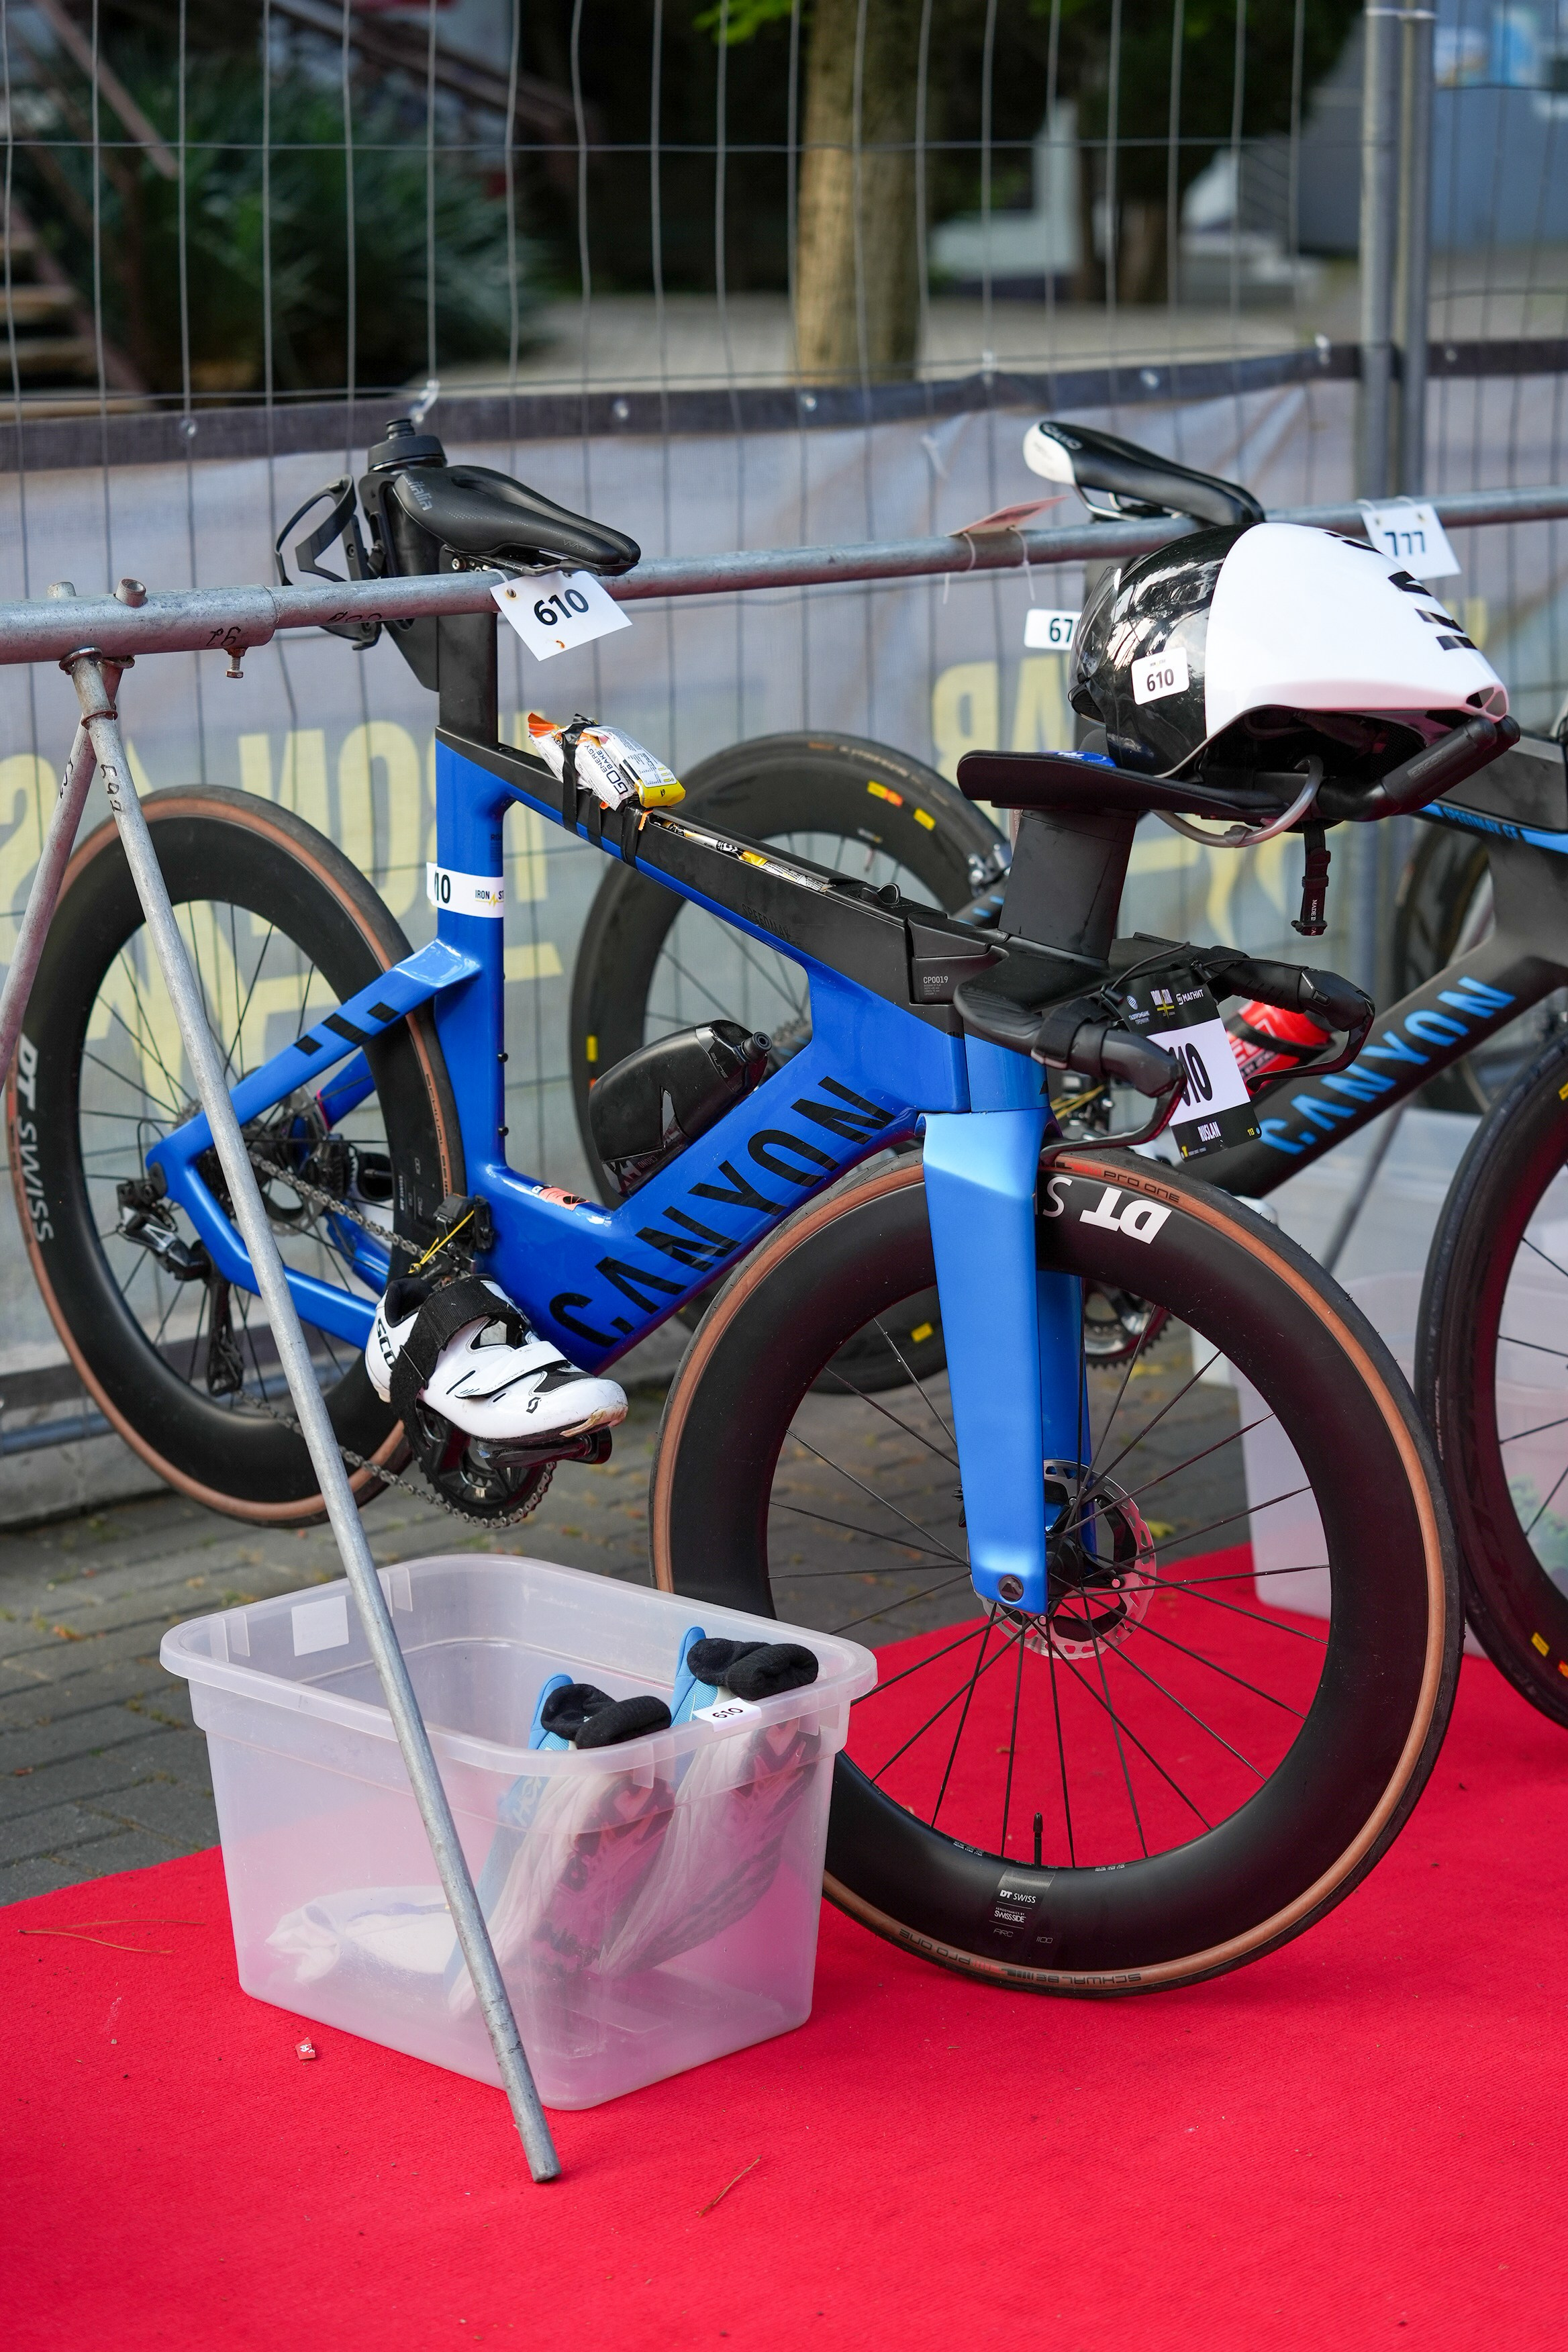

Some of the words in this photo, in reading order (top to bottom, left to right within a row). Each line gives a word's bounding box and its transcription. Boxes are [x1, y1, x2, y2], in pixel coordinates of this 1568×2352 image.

[562, 539, 594, 553] WATT
[1384, 532, 1426, 556] 777
[534, 589, 589, 626] 610
[1050, 618, 1079, 642] 67
[1146, 669, 1174, 691] 610
[584, 745, 608, 773] ENERGY
[596, 749, 614, 771] BAKE
[606, 770, 628, 795] GO
[434, 871, 451, 903] 10
[475, 889, 490, 899] IRON
[923, 975, 948, 984] CP0019
[1182, 989, 1204, 1003] МАГНИТ
[17, 1032, 39, 1112] DT
[1261, 977, 1516, 1155] CANYON
[1197, 1121, 1222, 1142] RUSLAN
[1247, 1128, 1255, 1136] 113
[637, 1155, 658, 1169] CRONO
[17, 1116, 55, 1242] SWISS
[548, 1076, 900, 1349] CANYON
[1079, 1186, 1173, 1244] DT
[377, 1318, 397, 1371] SCO
[712, 1708, 744, 1718] 610
[999, 1890, 1013, 1899] DT
[1013, 1893, 1036, 1904] SWISS
[995, 1907, 1020, 1916] AERODYNAMICS
[993, 1928, 1014, 1938] ARC
[1036, 1972, 1142, 1985] SCHWALBE
